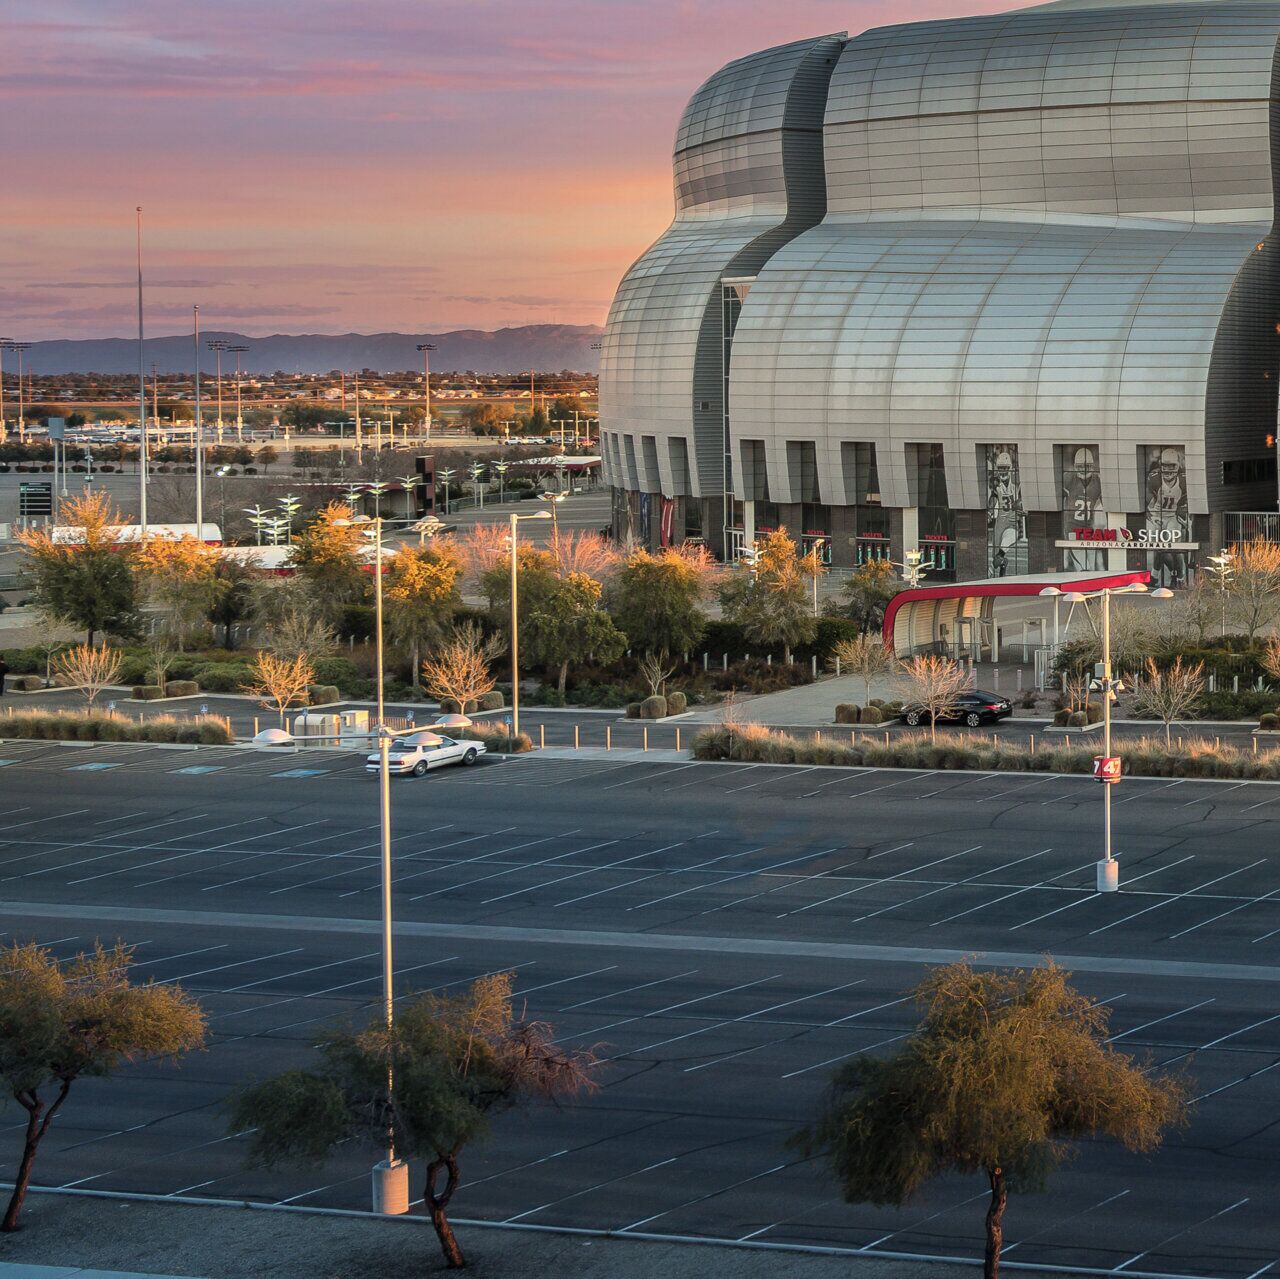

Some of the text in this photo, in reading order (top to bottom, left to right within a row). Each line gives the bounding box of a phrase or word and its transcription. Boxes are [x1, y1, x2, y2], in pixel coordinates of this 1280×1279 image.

[1075, 500, 1091, 521] 21
[1163, 497, 1175, 509] 11
[1073, 528, 1182, 543] TEAM SHOP
